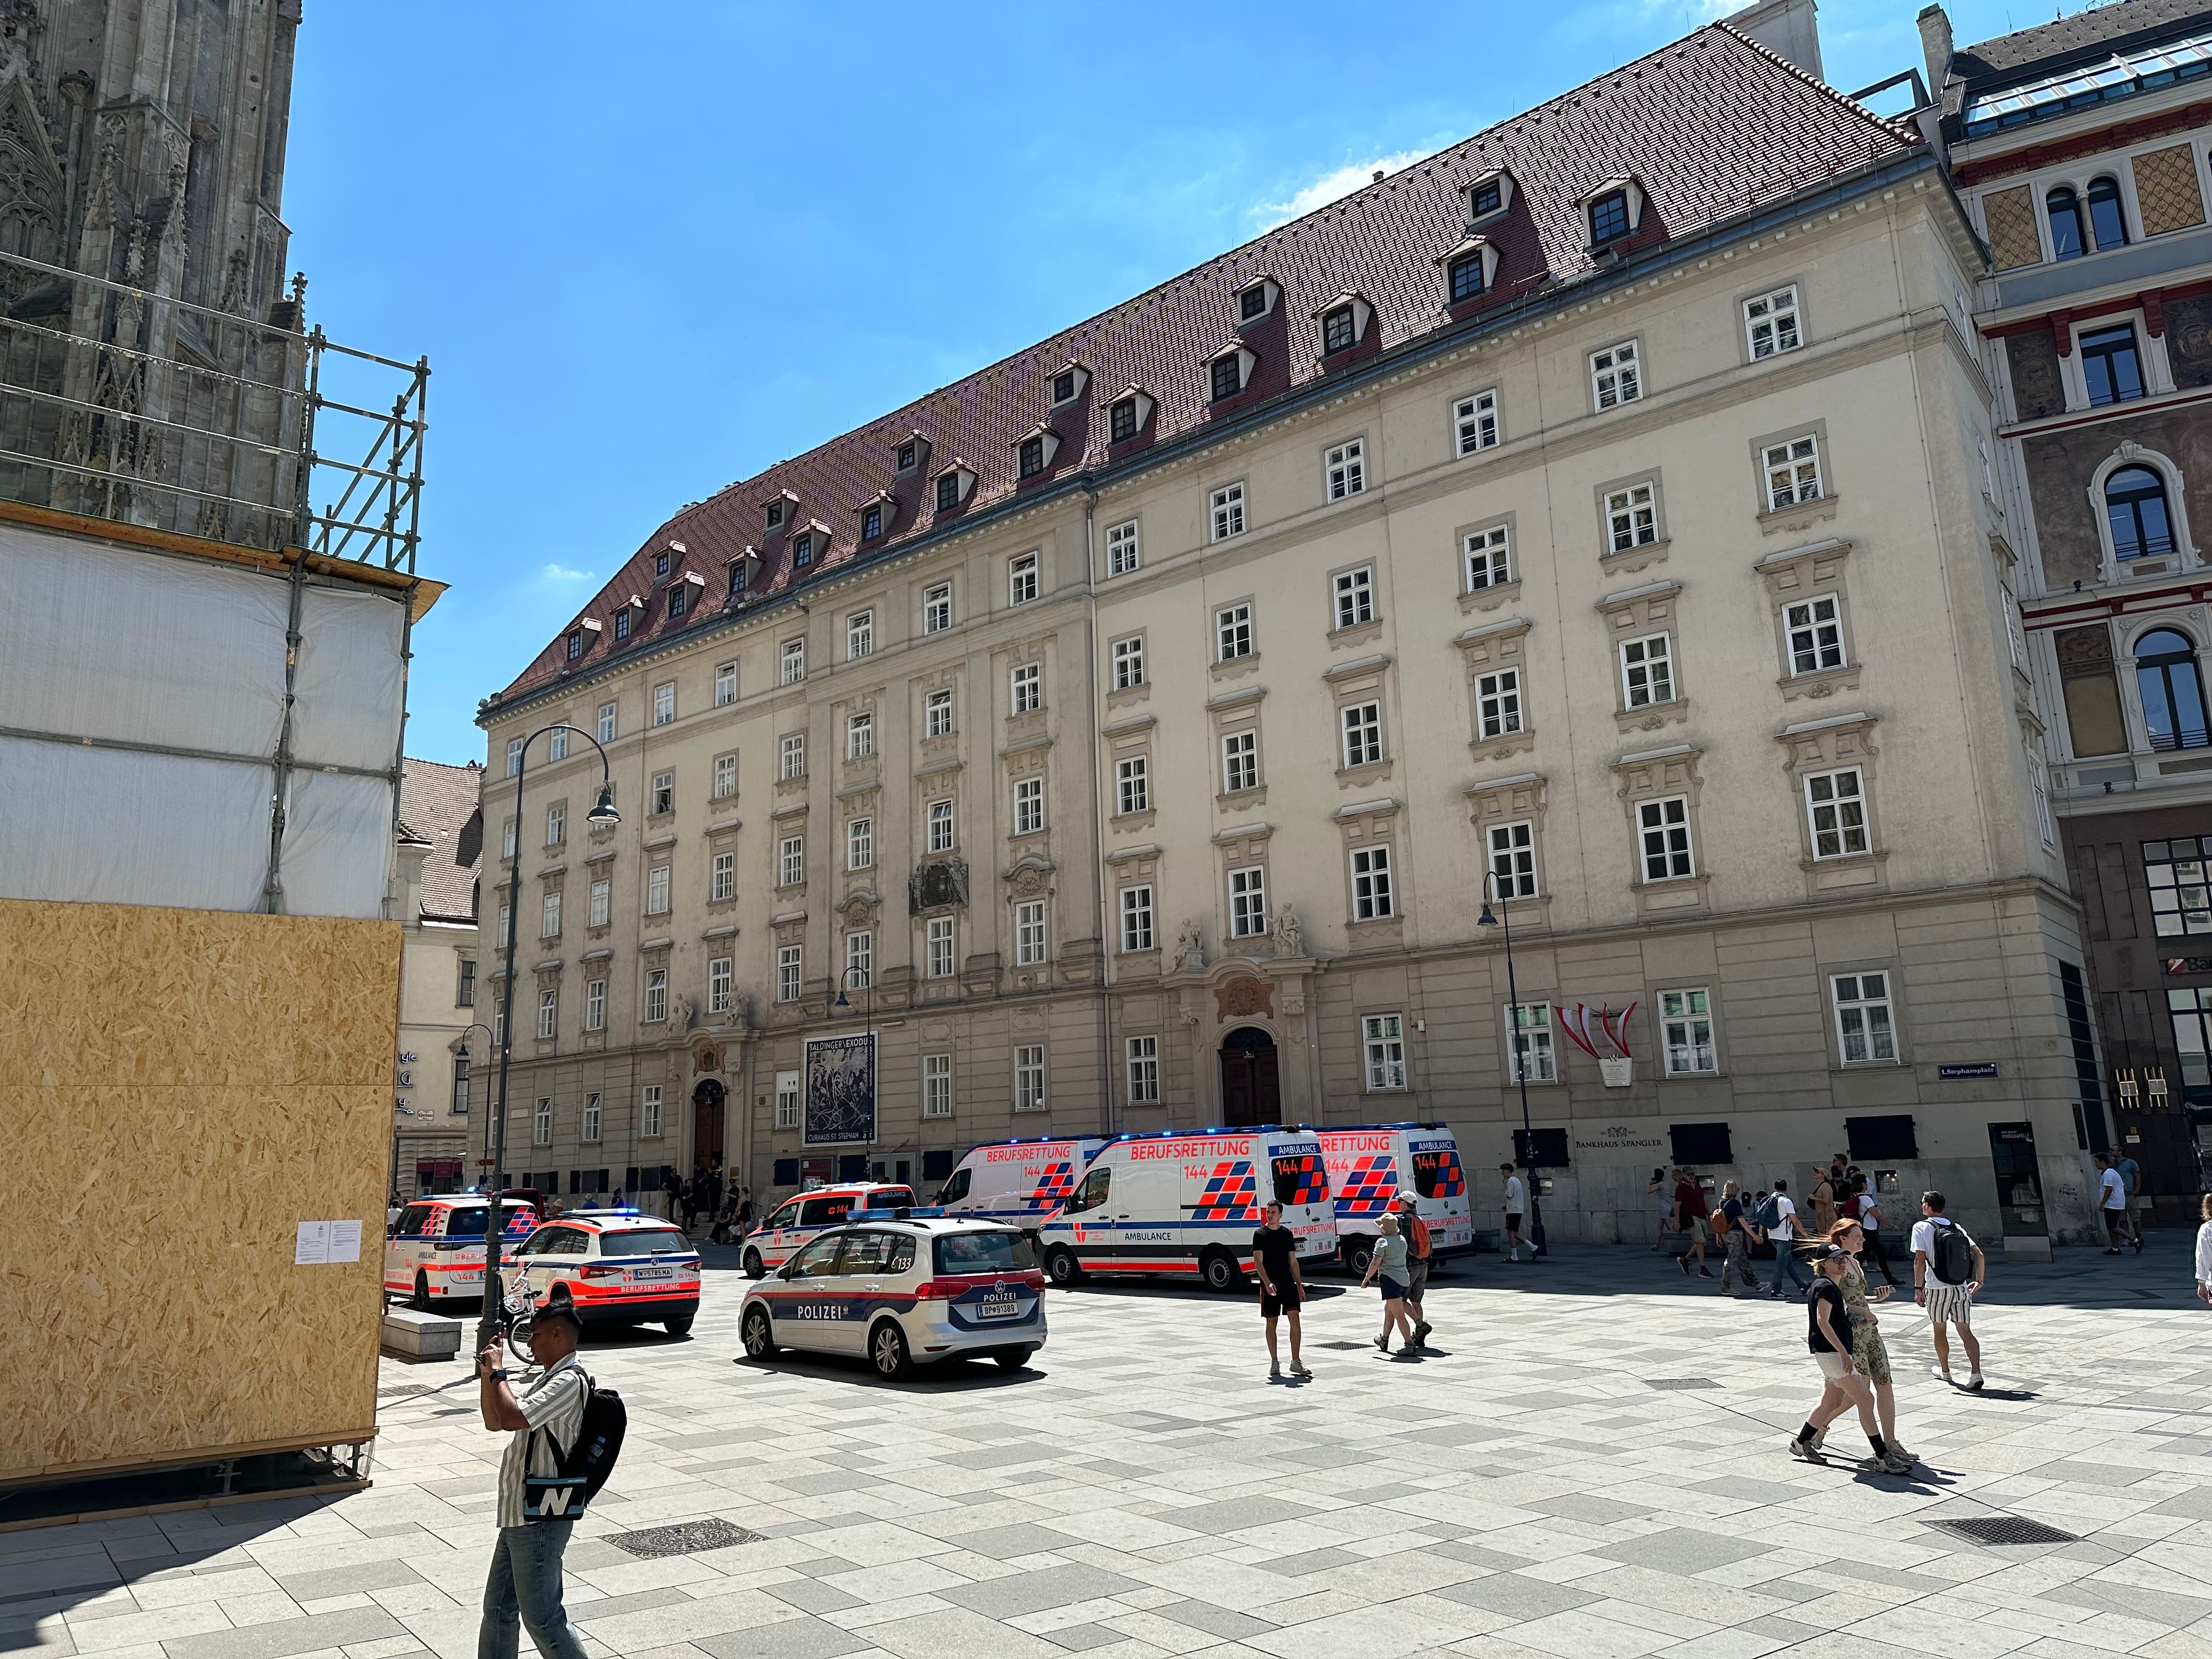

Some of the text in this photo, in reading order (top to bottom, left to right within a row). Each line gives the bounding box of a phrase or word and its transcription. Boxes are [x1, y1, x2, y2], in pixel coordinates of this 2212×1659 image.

[1131, 1140, 1249, 1160] BERUFSRETTUNG
[1279, 1144, 1317, 1155] AMBULANCE
[1318, 1136, 1390, 1151] RETTUNG
[1418, 1141, 1453, 1150] AMBULANCE
[987, 1146, 1071, 1162] BERUFSRETTUNG
[1276, 1159, 1298, 1176] 144
[1326, 1159, 1349, 1173] 144
[1415, 1155, 1436, 1170] 144
[1024, 1165, 1040, 1177] 144
[1184, 1164, 1208, 1180] 144
[837, 1204, 849, 1214] 144
[1427, 1215, 1470, 1228] BERUFSRETTUNG
[1290, 1222, 1334, 1236] ERUFSRETTUNG
[1125, 1232, 1172, 1240] AMBULANCE
[898, 1258, 912, 1270] 133
[621, 1283, 680, 1293] BERUFSRETTUNG
[984, 1292, 1016, 1302] POLIZEI
[798, 1306, 841, 1319] POLIZEI
[996, 1304, 1015, 1313] 91389
